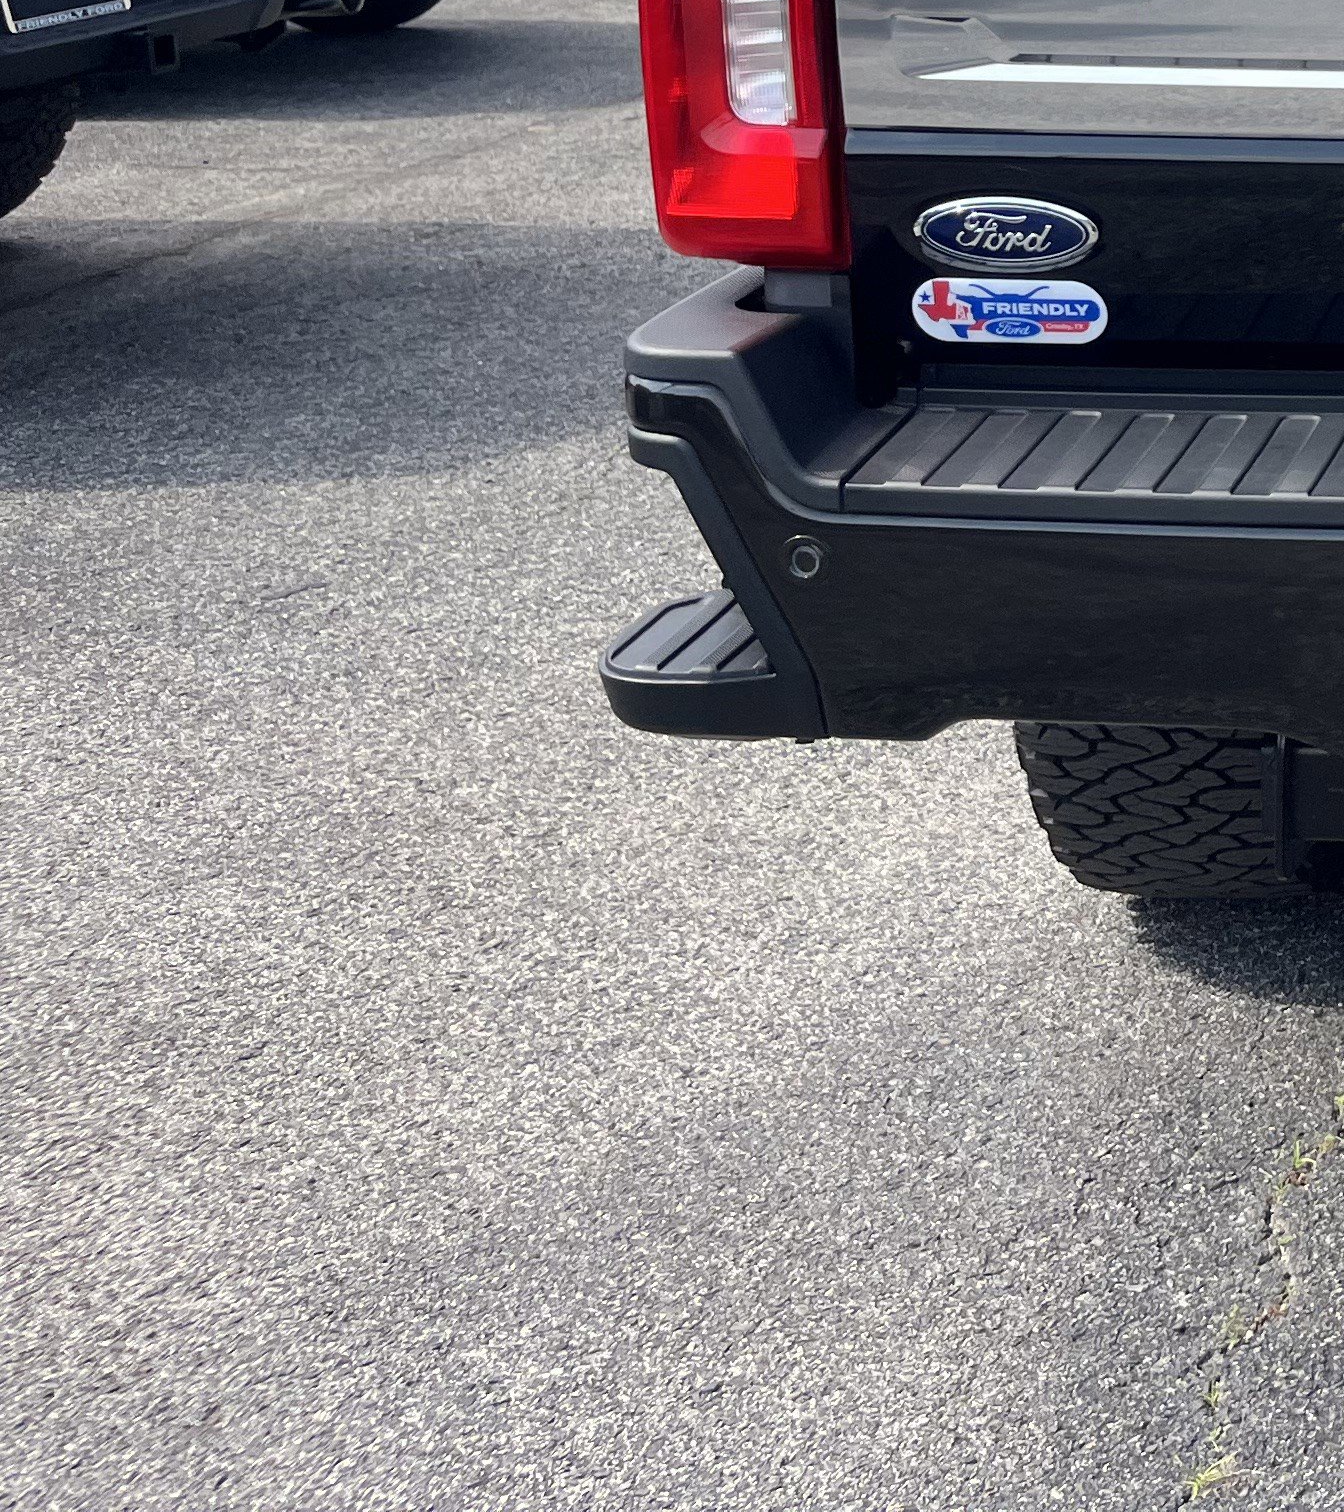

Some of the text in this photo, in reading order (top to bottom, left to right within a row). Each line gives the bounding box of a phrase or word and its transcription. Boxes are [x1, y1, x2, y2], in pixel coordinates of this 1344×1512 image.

[955, 211, 1053, 252] Ford
[982, 301, 1090, 317] FRIENDLY
[995, 320, 1032, 335] Ford
